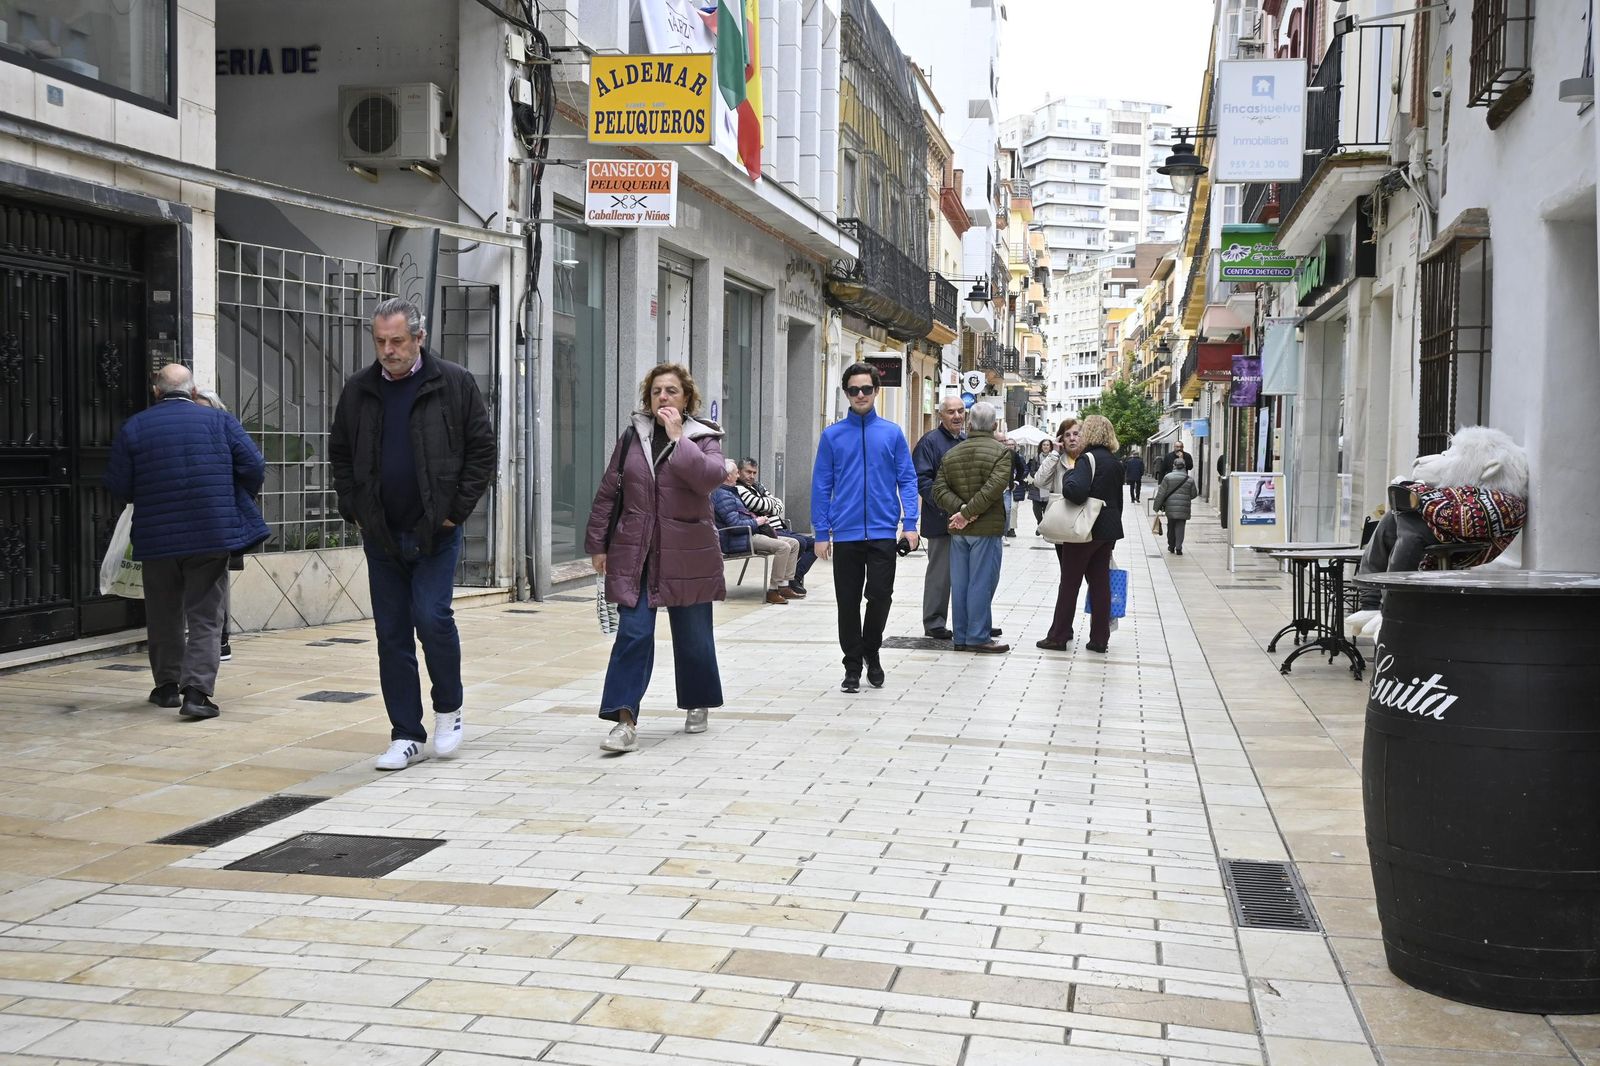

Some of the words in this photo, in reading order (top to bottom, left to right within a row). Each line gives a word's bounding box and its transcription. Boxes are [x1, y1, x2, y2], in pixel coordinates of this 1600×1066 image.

[281, 45, 321, 74] DE
[594, 61, 708, 97] ALDEMAR
[594, 109, 706, 135] PELUQUEROS
[1233, 136, 1289, 146] Inmobiliaria
[590, 179, 670, 192] PELUQUERIA
[588, 209, 635, 221] Caballeros
[636, 212, 642, 223] y
[645, 210, 670, 221] Niños
[1226, 268, 1254, 276] CENTRO
